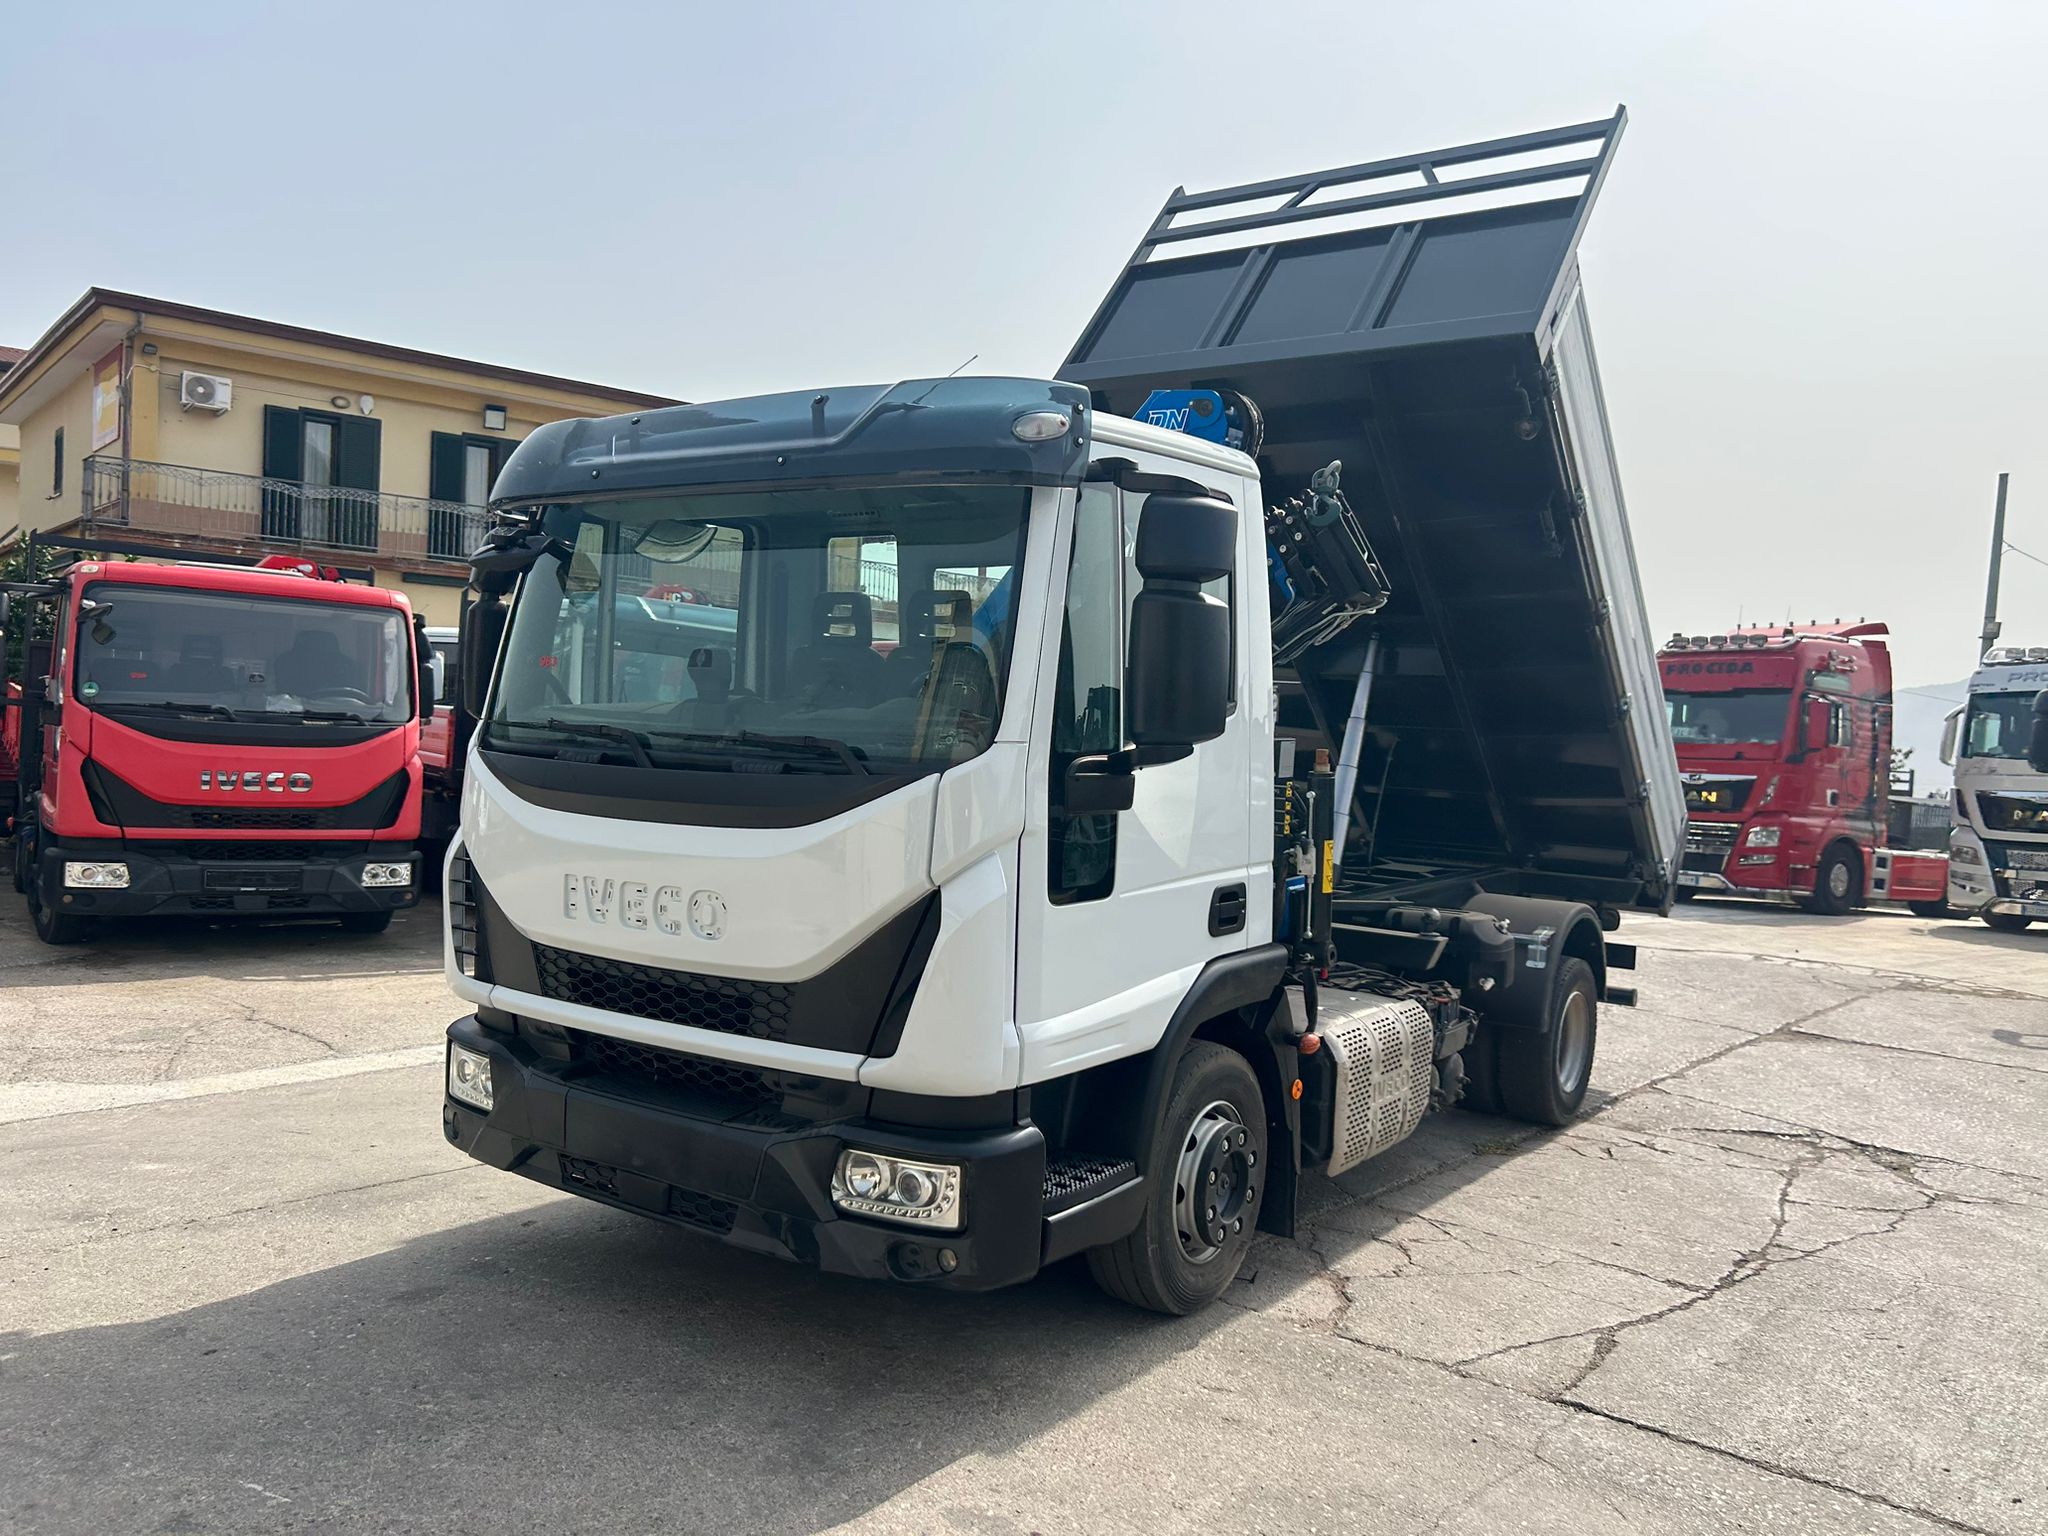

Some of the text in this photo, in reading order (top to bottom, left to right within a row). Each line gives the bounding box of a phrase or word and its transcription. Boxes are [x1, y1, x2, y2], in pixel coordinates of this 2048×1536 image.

[200, 770, 313, 793] IVECO
[1686, 789, 1717, 802] AN
[563, 873, 729, 941] IVECO
